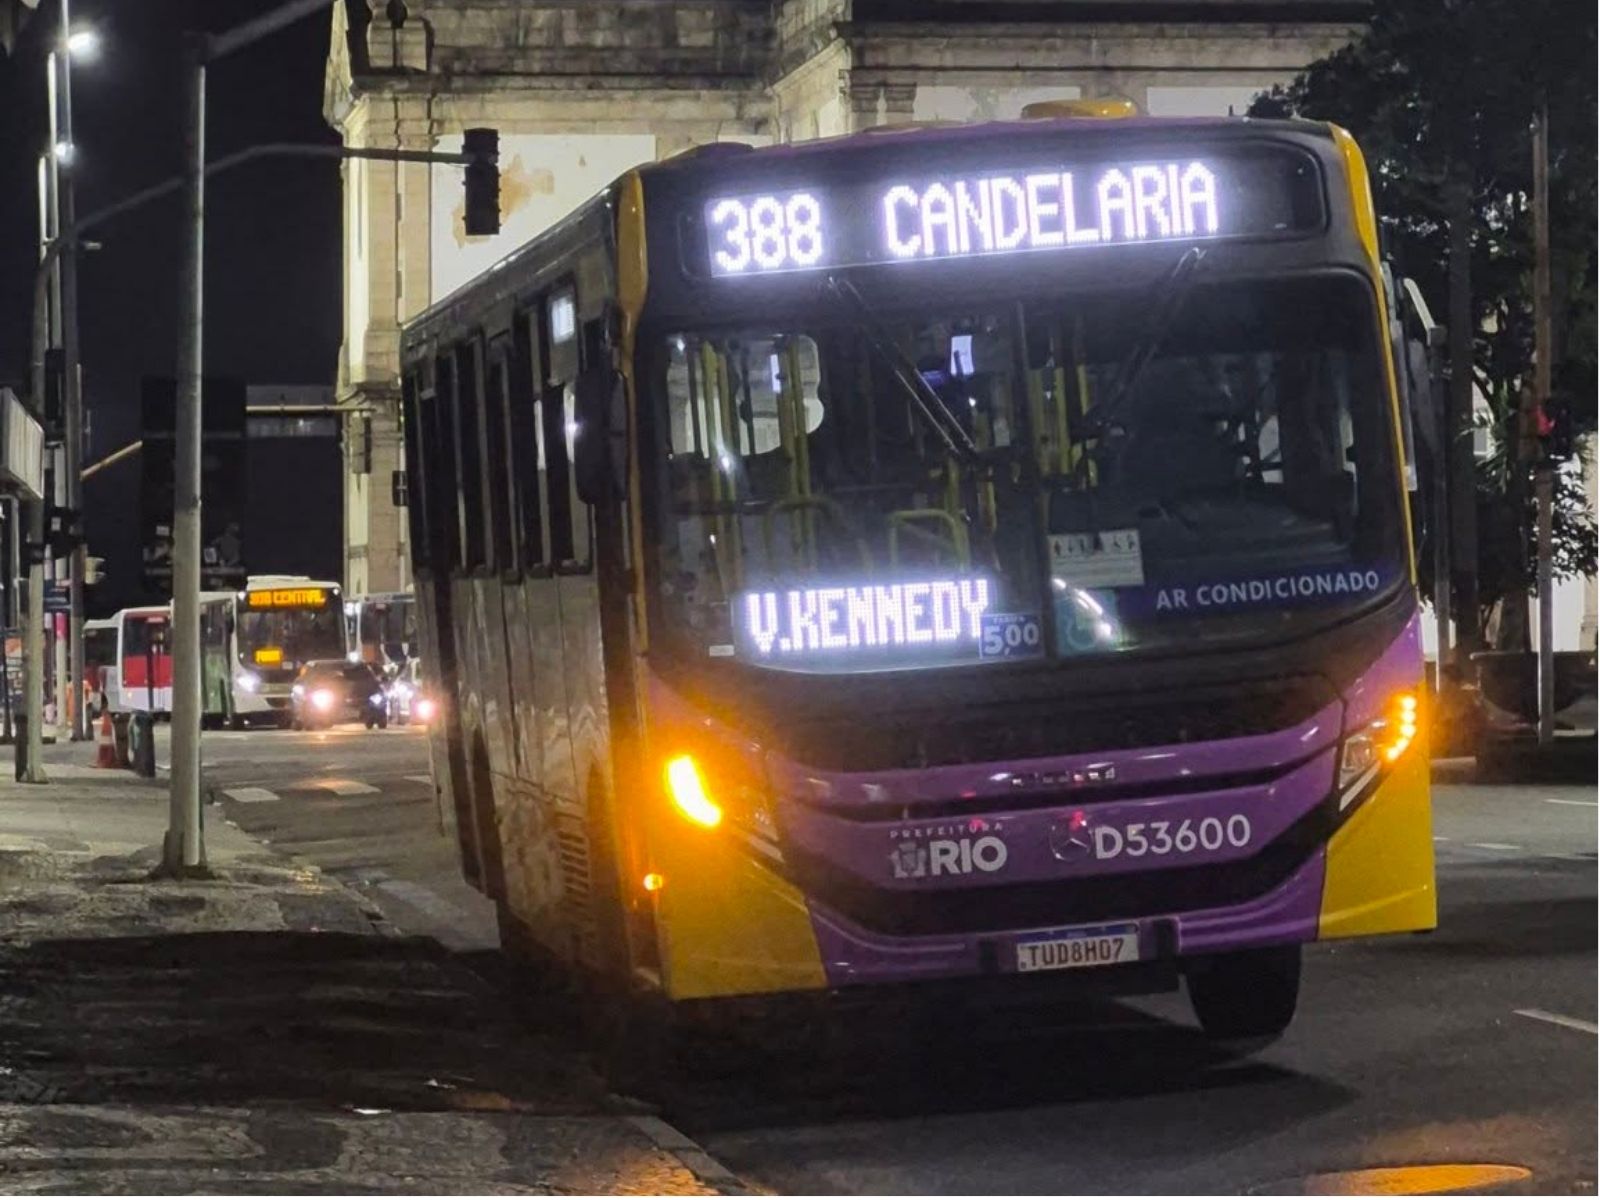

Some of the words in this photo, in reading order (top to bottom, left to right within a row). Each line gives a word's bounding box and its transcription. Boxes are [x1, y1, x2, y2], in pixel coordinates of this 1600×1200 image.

[711, 193, 823, 271] 388
[884, 161, 1218, 258] CANDELARIA
[1156, 589, 1188, 611] AR
[1195, 570, 1380, 606] CONDICIONADO
[745, 578, 989, 653] V.KENNEDY
[983, 622, 1040, 656] 5,00
[889, 822, 1003, 839] PREFEITURA
[1094, 814, 1251, 860] D53600
[929, 836, 1008, 876] RIO
